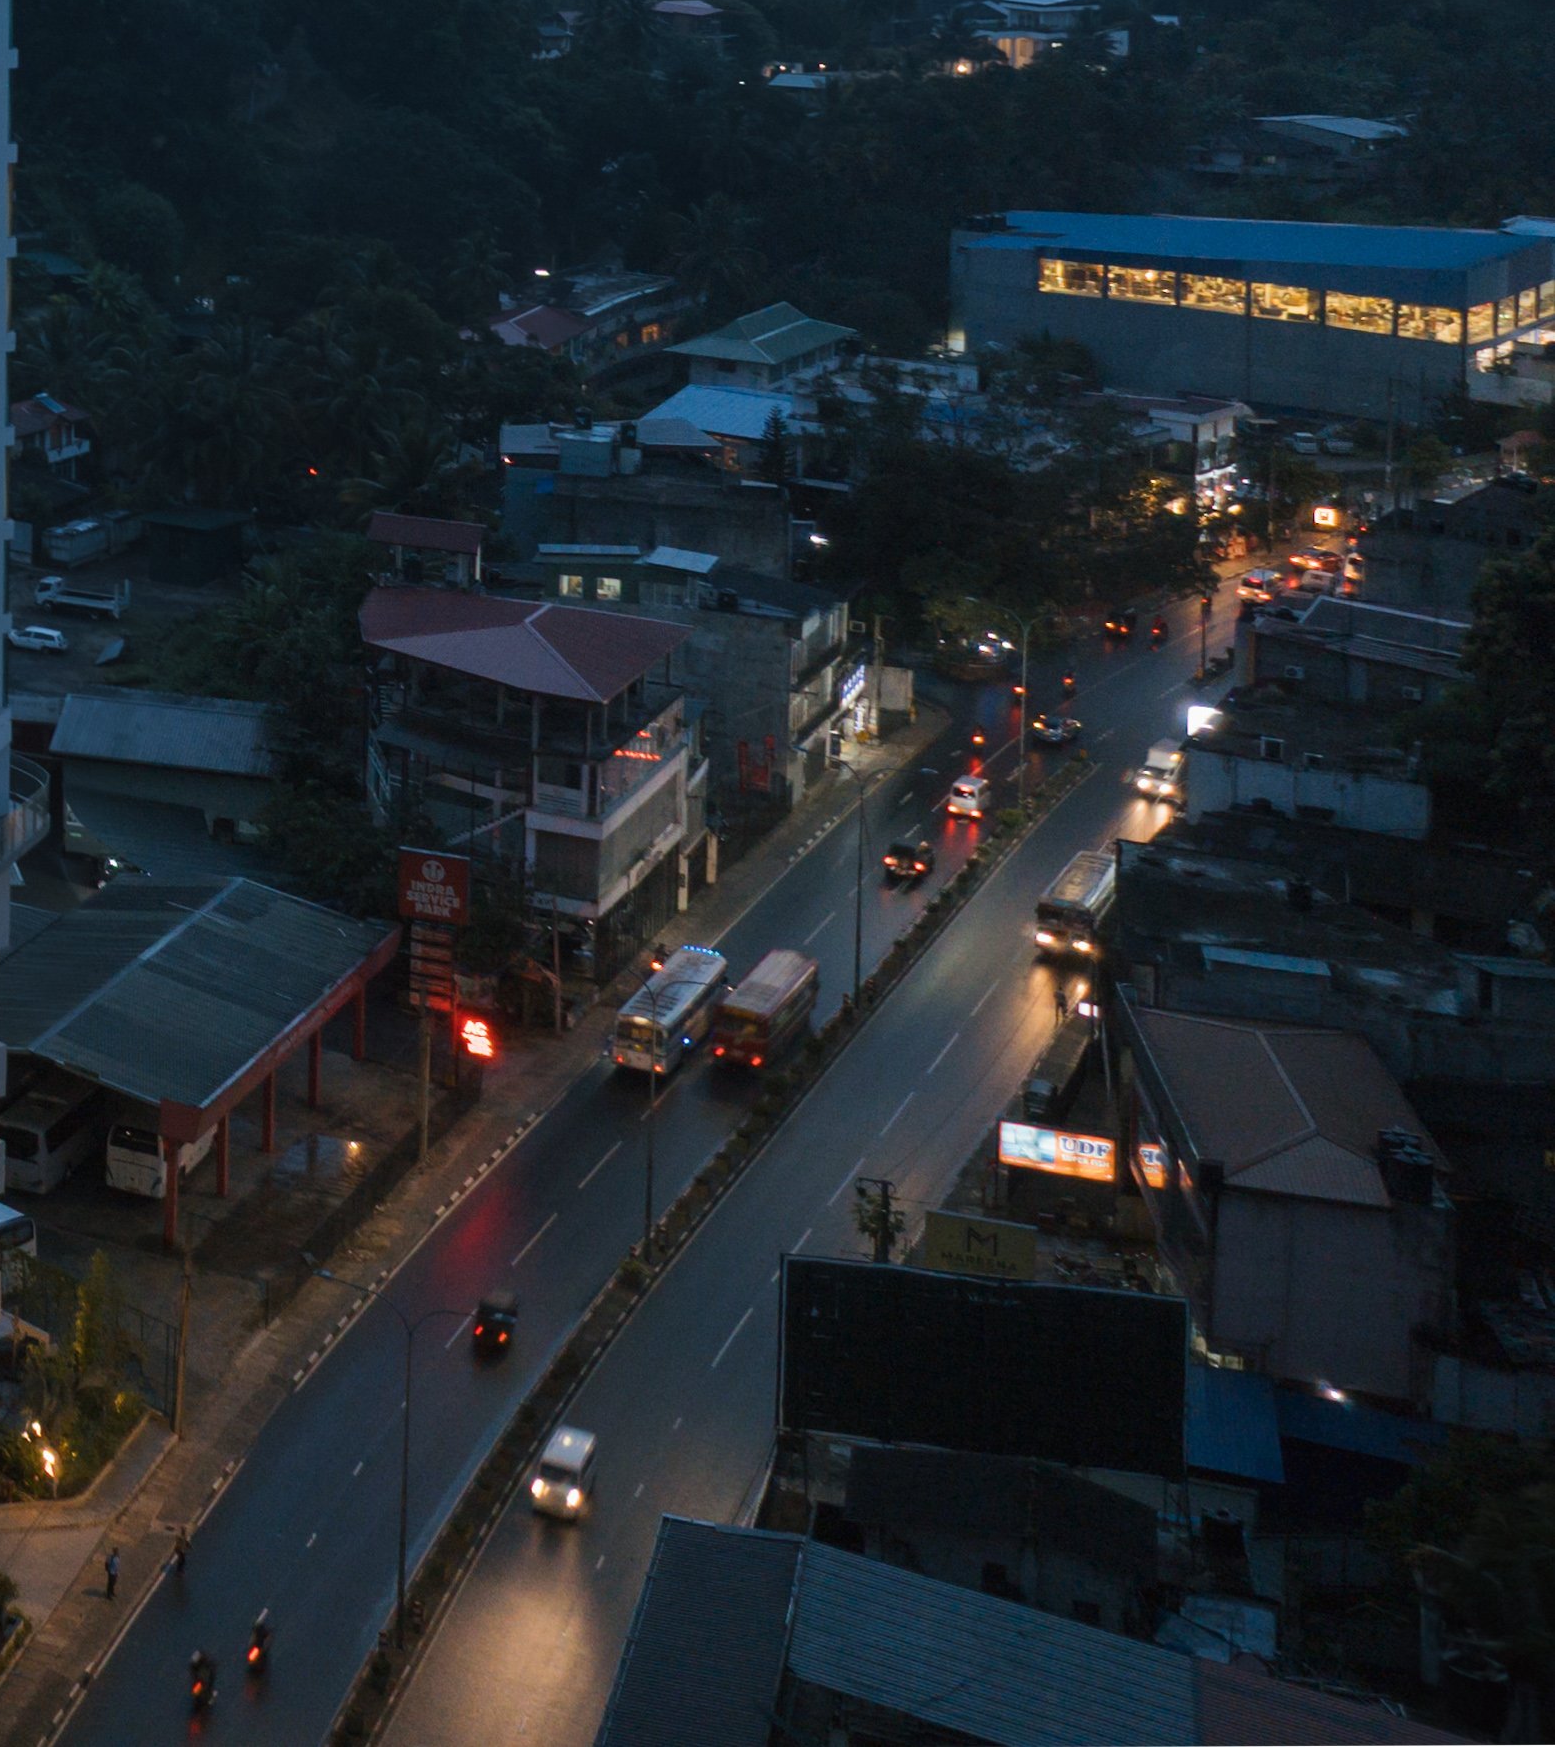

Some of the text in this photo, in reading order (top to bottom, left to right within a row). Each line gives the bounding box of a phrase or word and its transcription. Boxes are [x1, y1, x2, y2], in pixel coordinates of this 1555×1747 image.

[410, 879, 455, 897] INDRA
[406, 890, 460, 909] SERVICE
[415, 902, 451, 918] PARK
[1060, 1137, 1111, 1157] UDF
